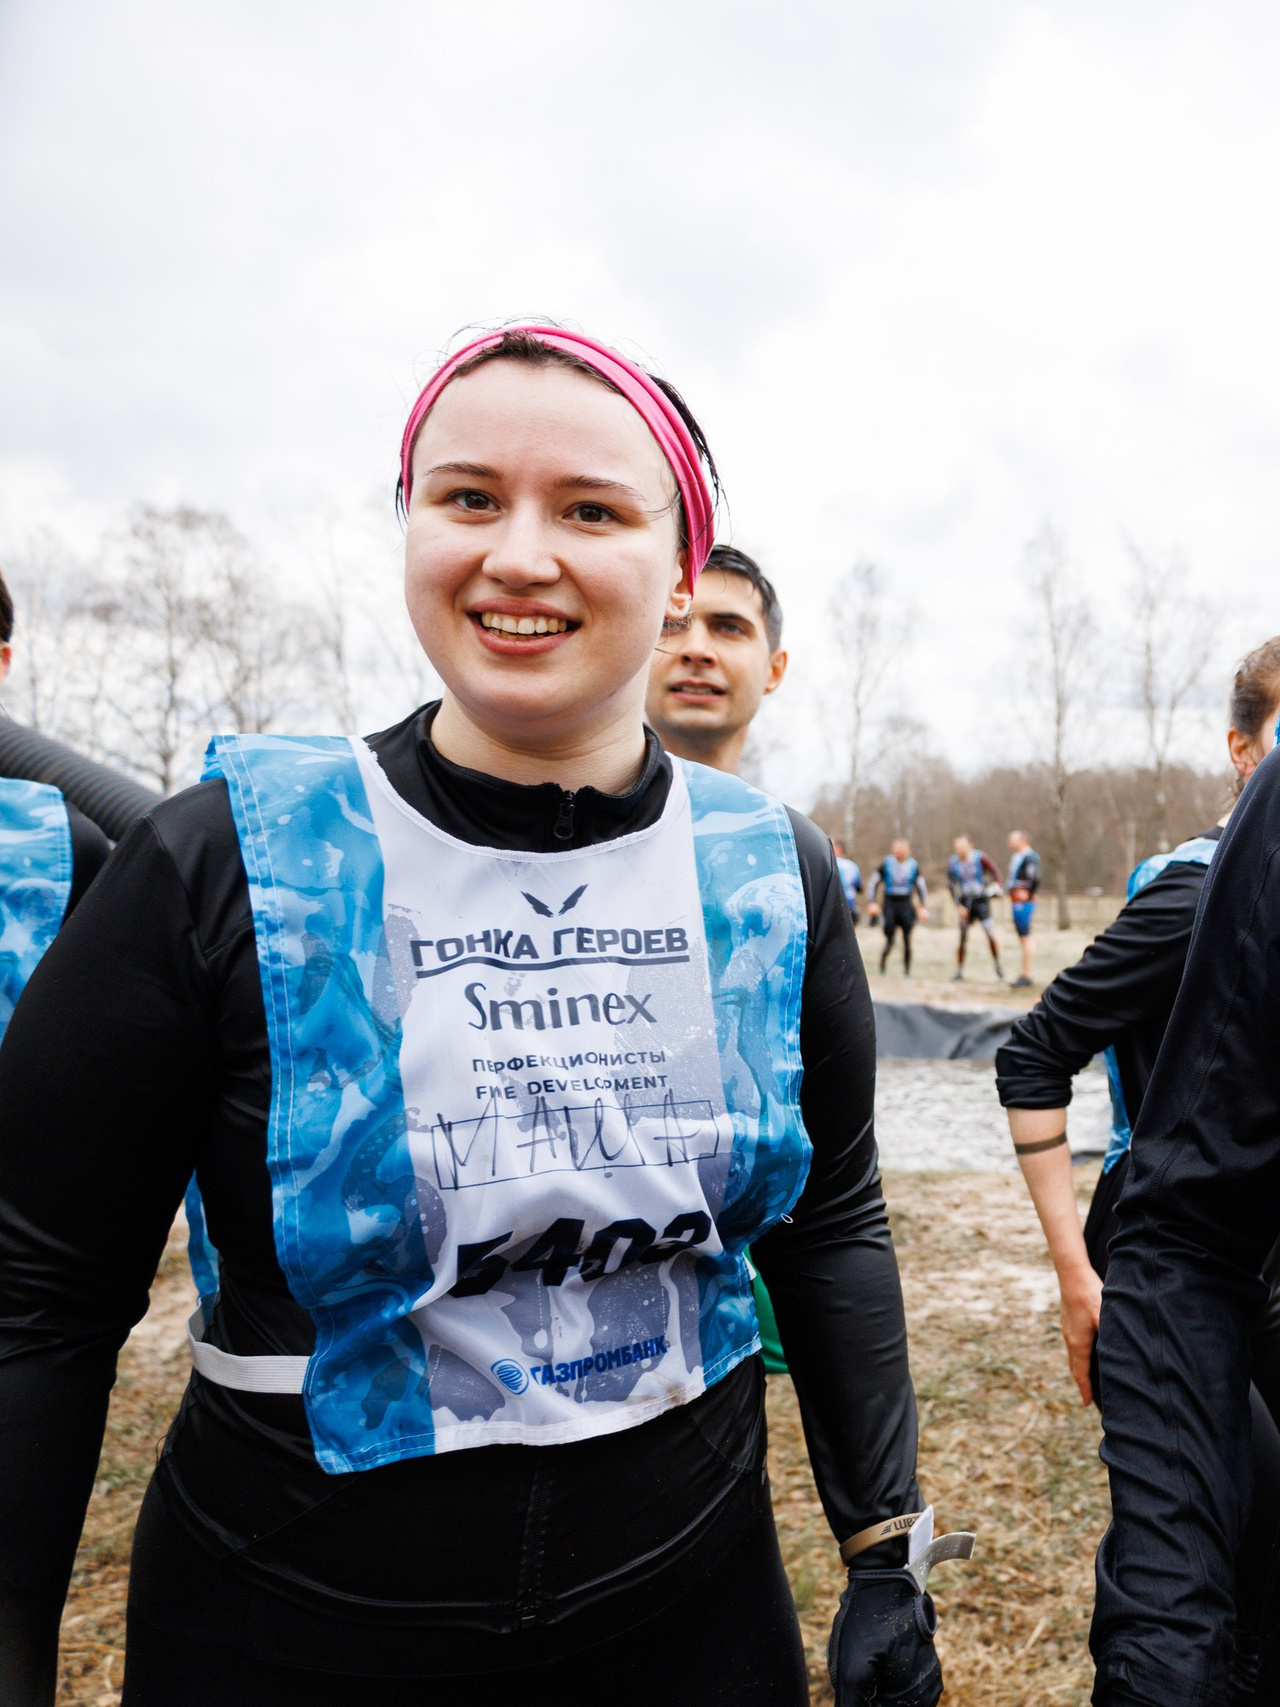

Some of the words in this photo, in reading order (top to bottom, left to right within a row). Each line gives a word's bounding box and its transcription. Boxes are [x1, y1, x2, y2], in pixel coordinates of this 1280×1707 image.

[409, 928, 540, 967] ГОНКА
[552, 926, 690, 956] ГЕРОЕВ
[463, 981, 658, 1031] Sminex
[471, 1050, 667, 1073] ПЕРФЕКЦИОНИСТЫ
[526, 1075, 669, 1096] DEVELOPMENT
[529, 1334, 670, 1386] ГАЗПРОМБАНК
